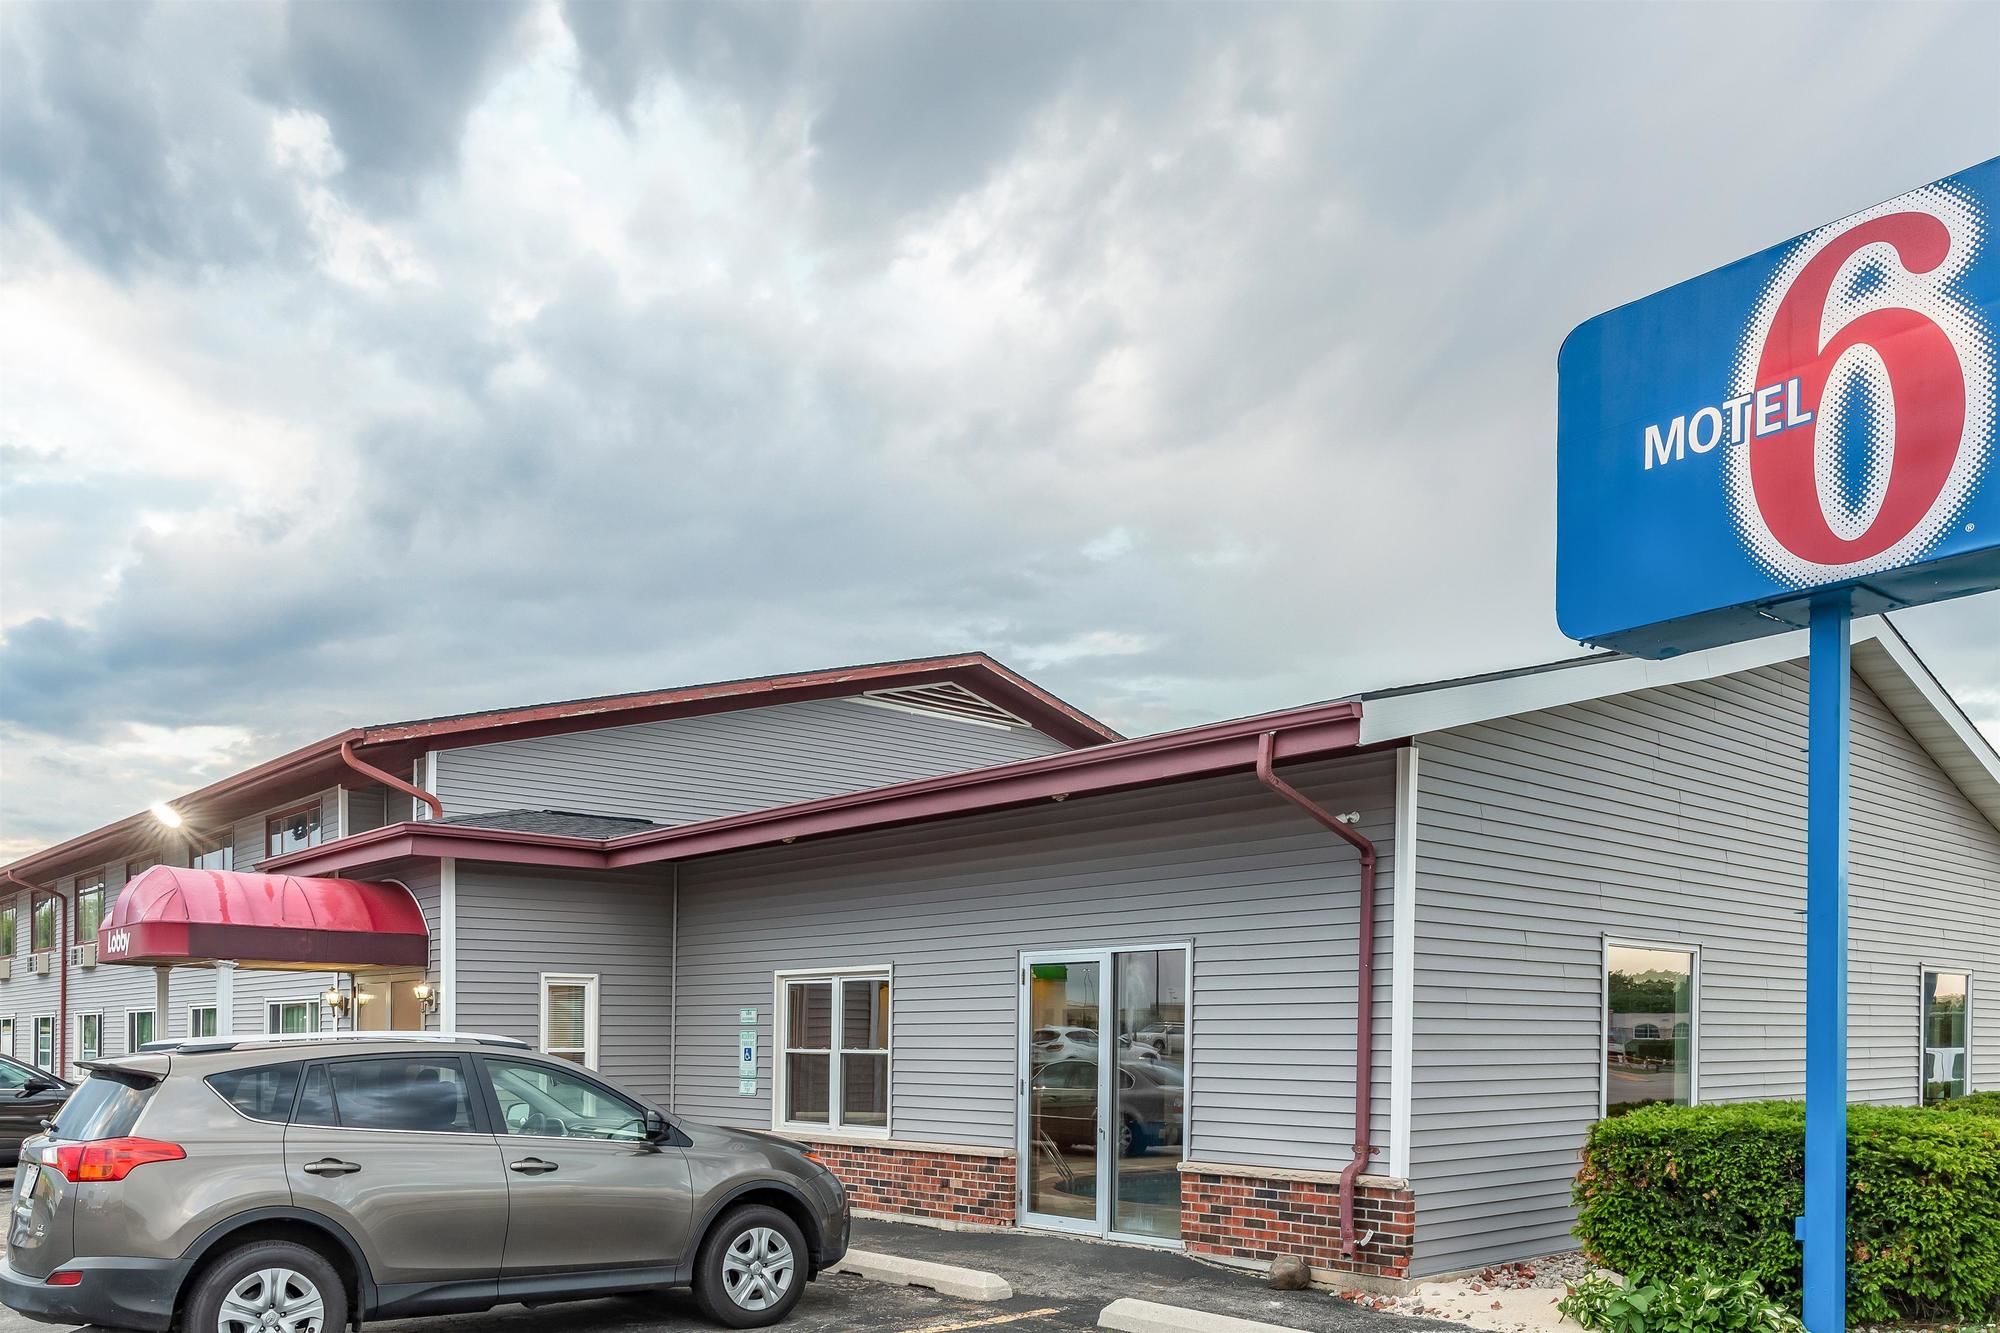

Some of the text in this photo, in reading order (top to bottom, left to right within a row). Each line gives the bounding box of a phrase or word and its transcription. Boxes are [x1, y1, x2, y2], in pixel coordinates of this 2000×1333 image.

[1644, 211, 1966, 565] MOTEL 6
[107, 928, 130, 955] Lobby
